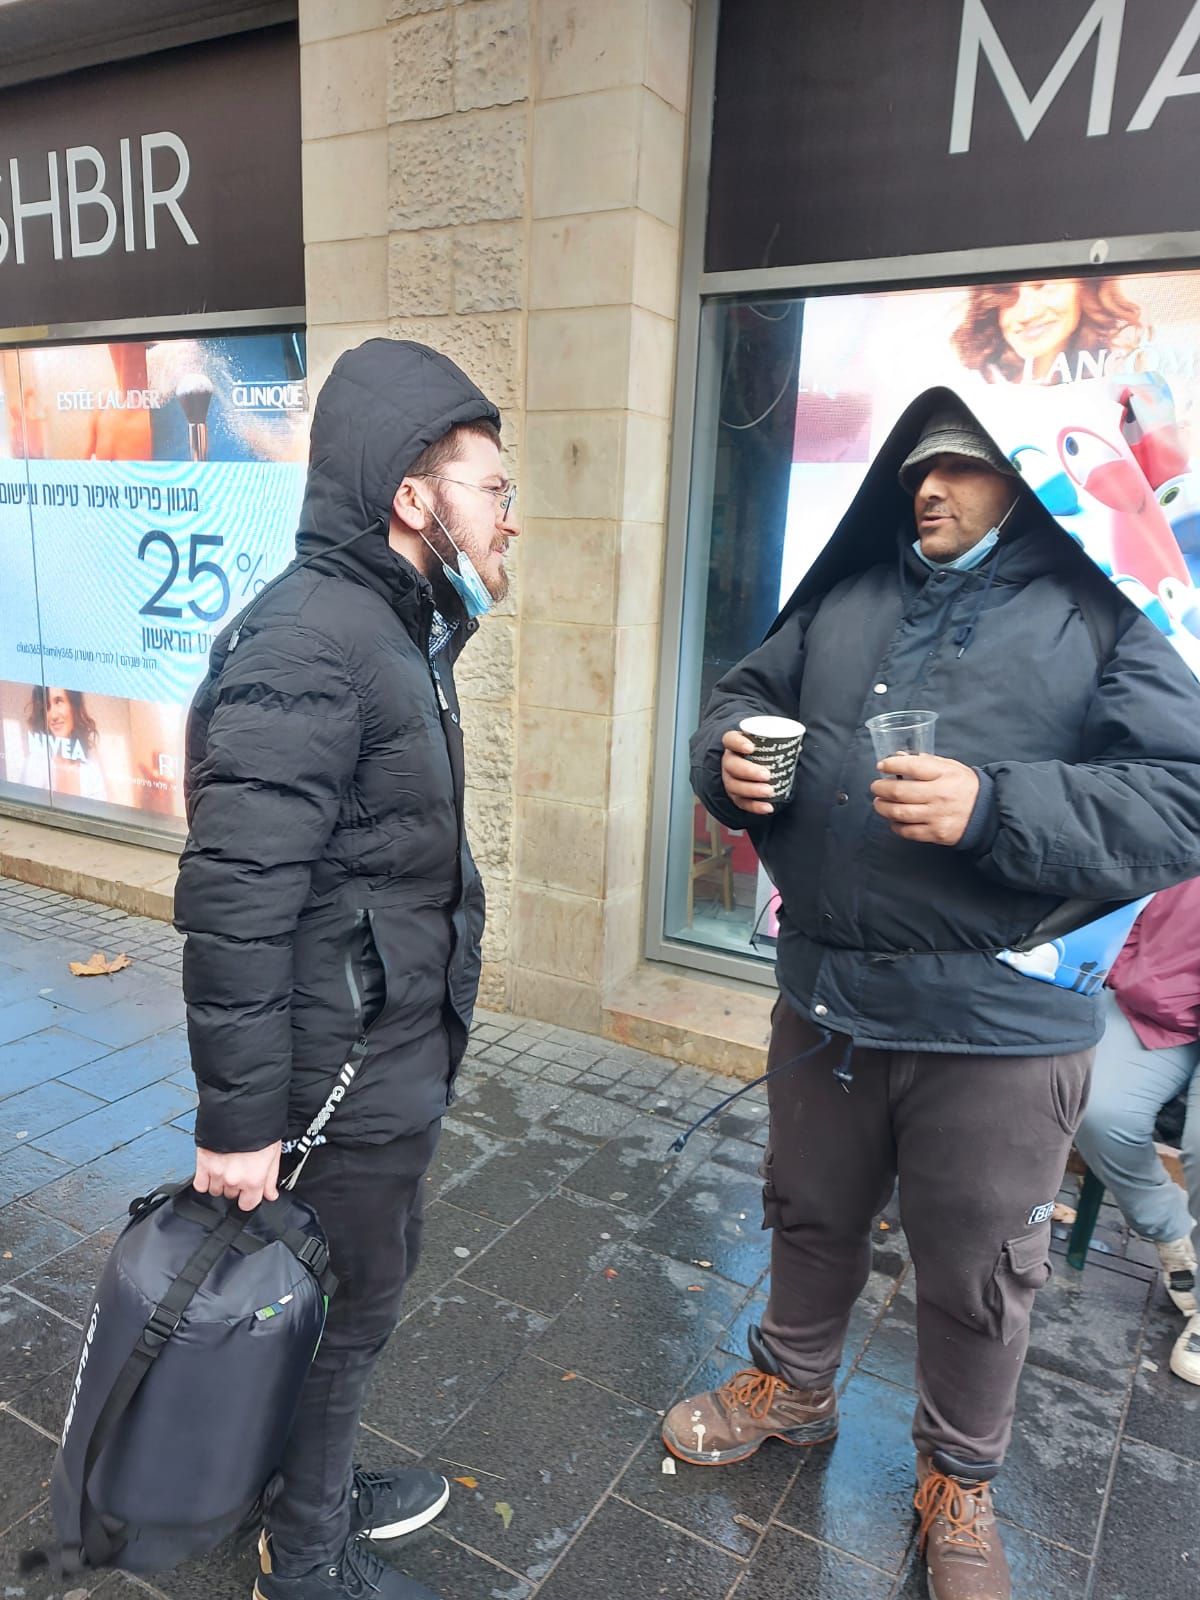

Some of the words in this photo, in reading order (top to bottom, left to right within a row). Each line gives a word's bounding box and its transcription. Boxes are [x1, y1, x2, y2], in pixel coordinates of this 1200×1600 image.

[0, 131, 200, 265] HBIR
[231, 384, 304, 409] CLINIQUE
[43, 483, 78, 507] טיפוח
[82, 484, 119, 509] איפור
[124, 485, 161, 511] פריטי
[167, 486, 199, 516] מגוון
[142, 626, 192, 653] הראשון
[28, 731, 87, 763] NIVEA
